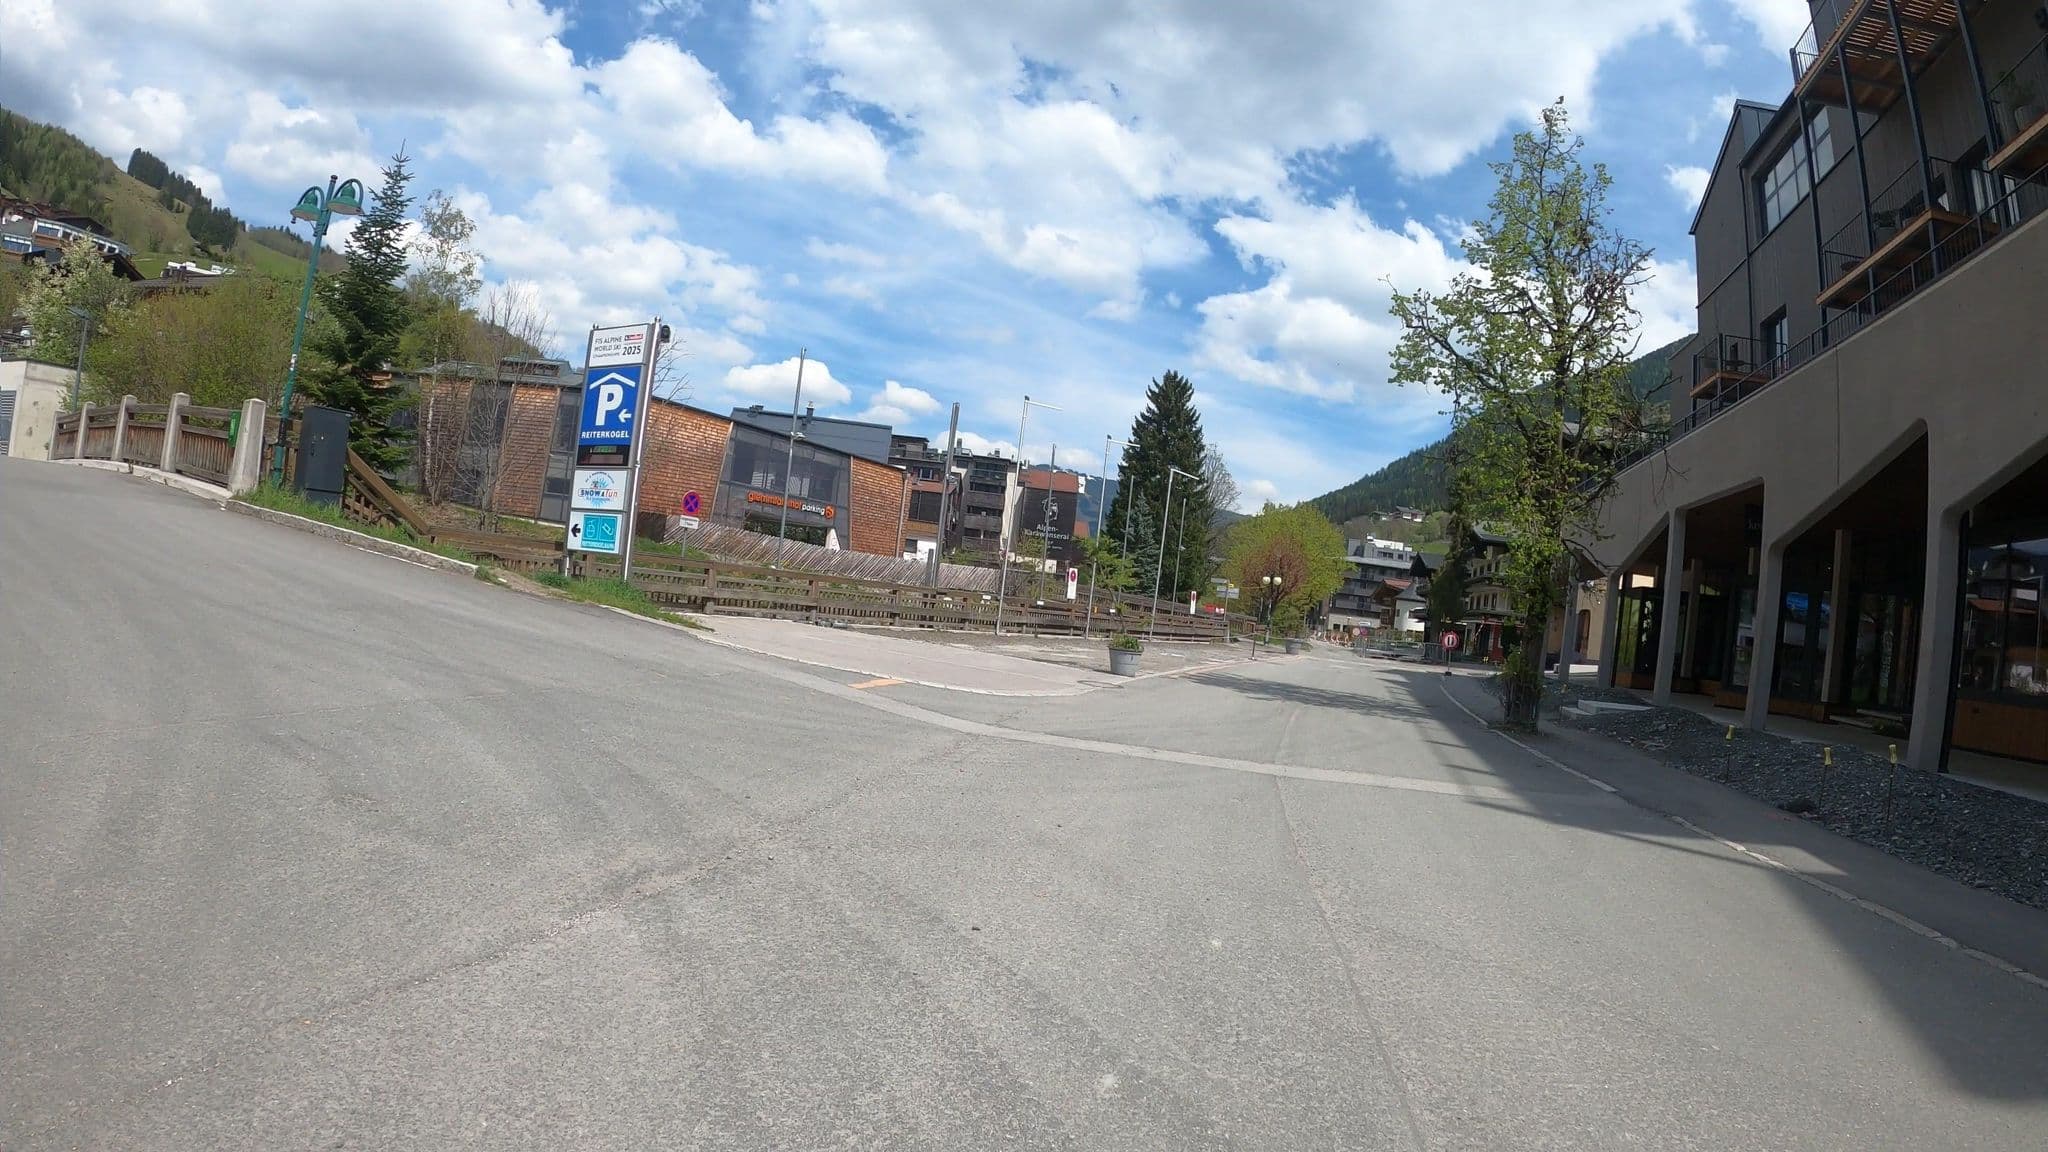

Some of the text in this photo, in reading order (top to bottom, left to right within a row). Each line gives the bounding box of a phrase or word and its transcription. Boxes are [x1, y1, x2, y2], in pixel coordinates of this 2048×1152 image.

[604, 336, 622, 344] ALPINE
[622, 345, 641, 356] 2025
[595, 384, 624, 426] P
[581, 430, 630, 439] REITERKOGEL
[801, 503, 826, 516] parking
